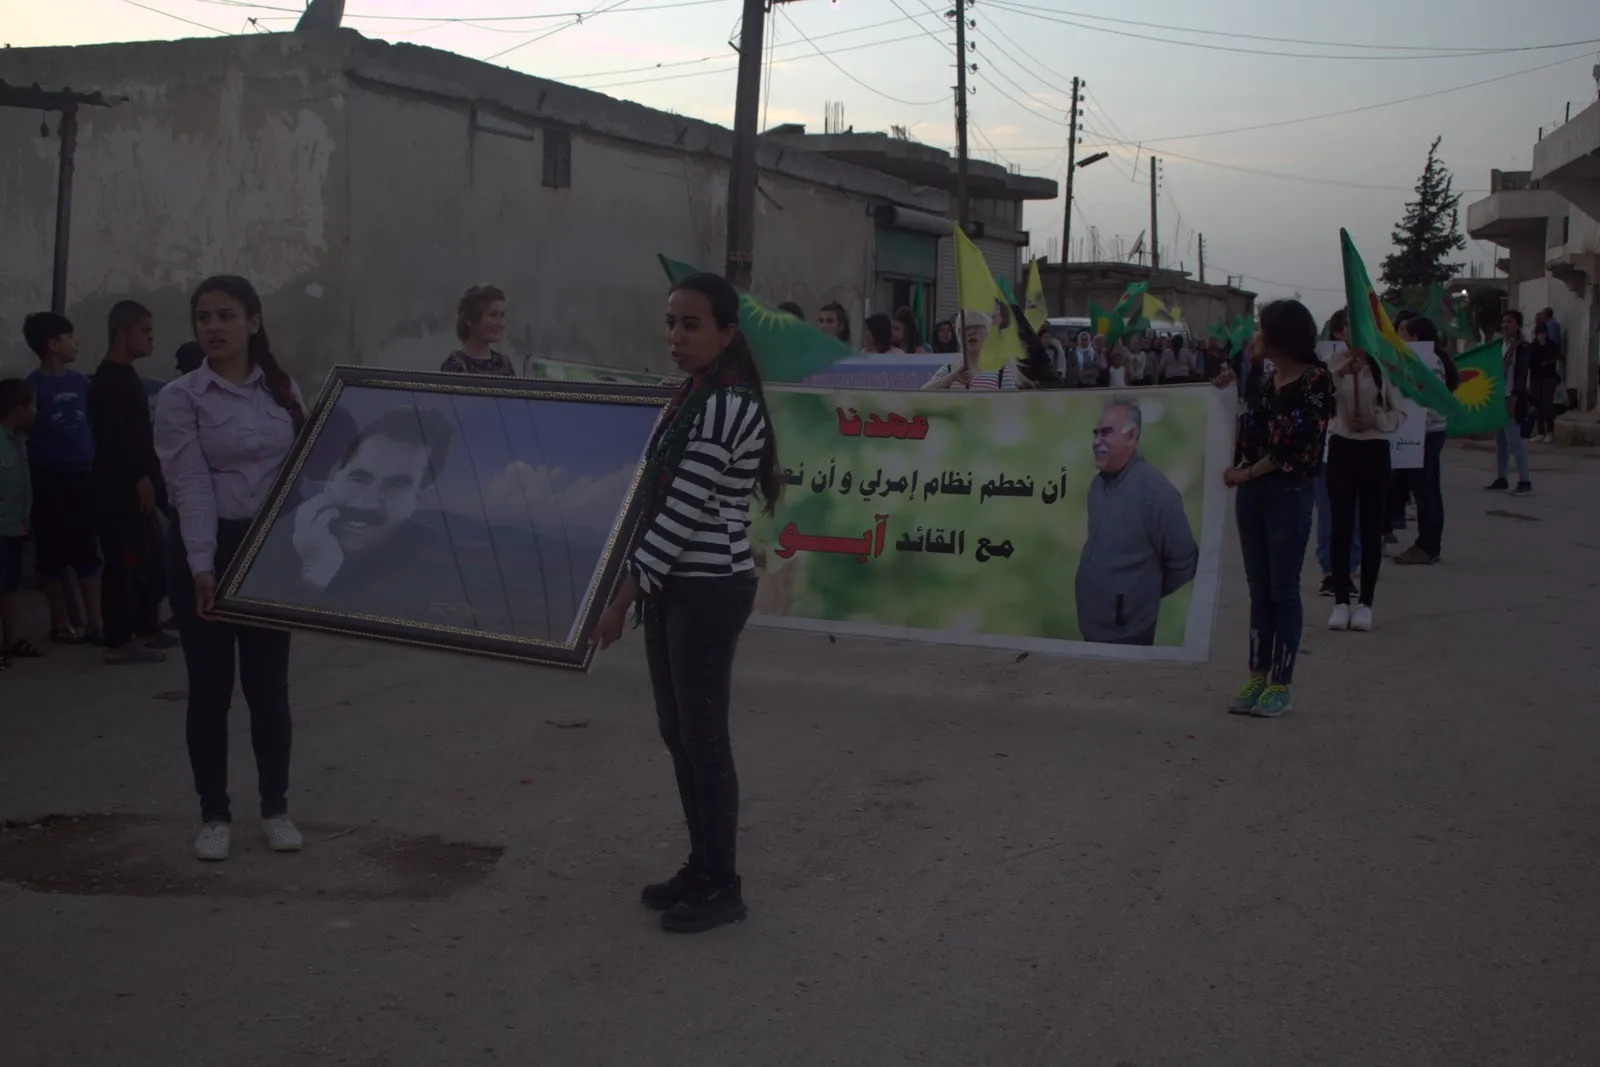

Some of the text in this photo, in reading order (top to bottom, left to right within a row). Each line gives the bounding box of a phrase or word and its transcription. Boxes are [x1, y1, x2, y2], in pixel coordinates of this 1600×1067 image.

[836, 407, 930, 440] عهدنا
[859, 468, 918, 501] إمرلي
[924, 470, 973, 502] نظام
[980, 472, 1034, 504] نحطم
[1041, 467, 1067, 504] أن
[895, 526, 965, 554] القائد
[975, 537, 1014, 562] مع
